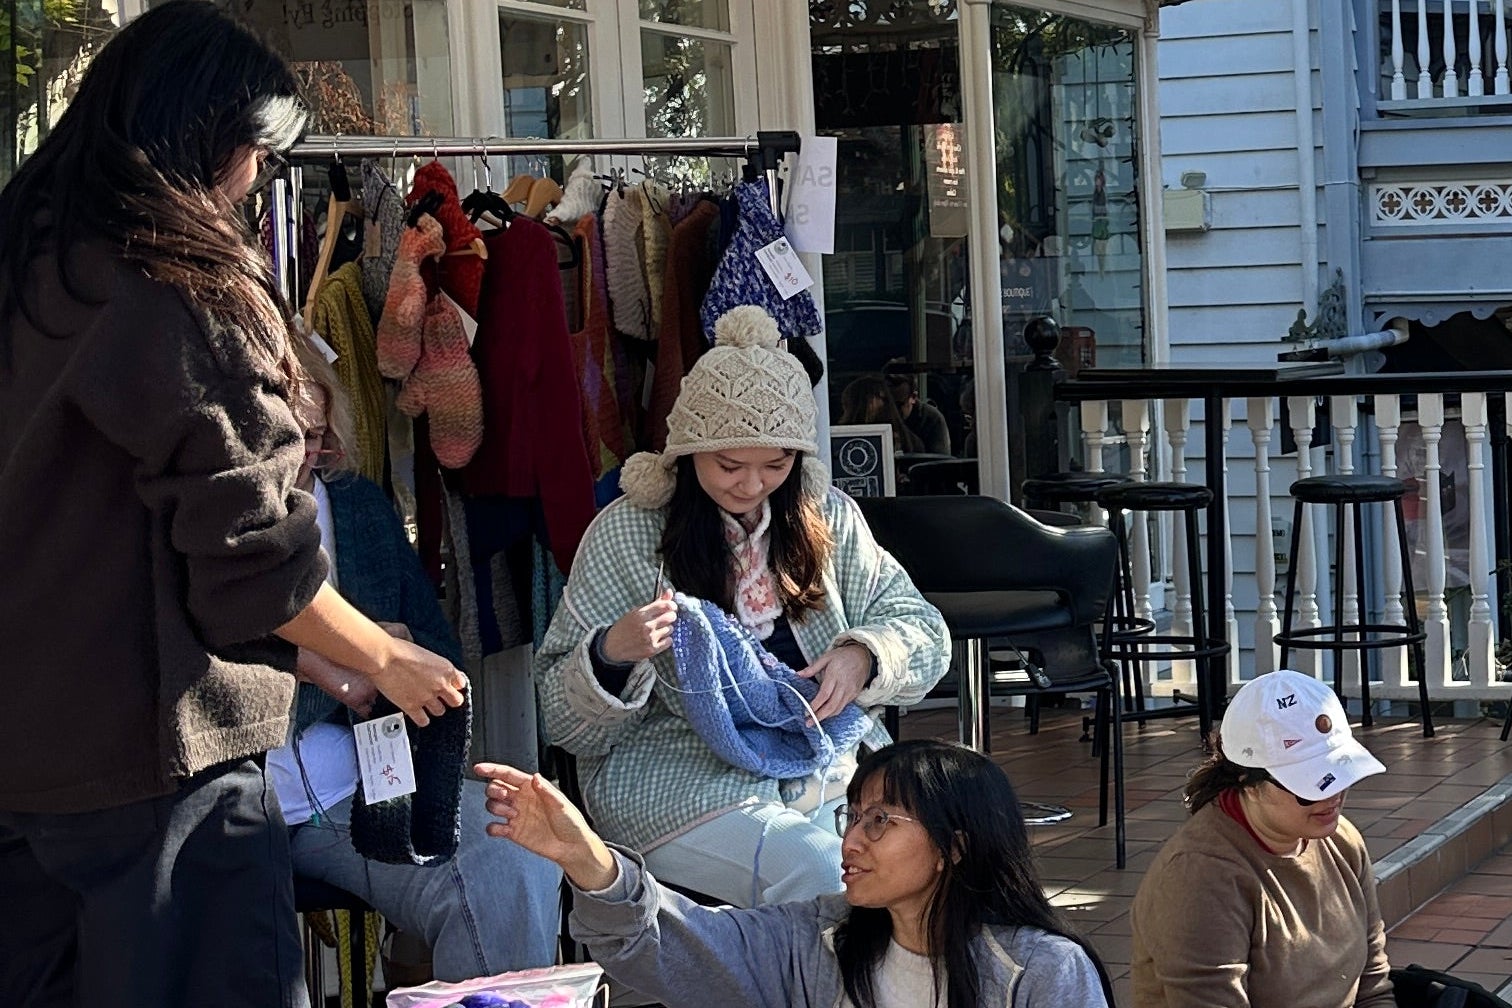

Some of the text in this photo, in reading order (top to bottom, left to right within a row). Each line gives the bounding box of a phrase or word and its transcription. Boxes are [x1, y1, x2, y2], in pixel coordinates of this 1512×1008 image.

[784, 272, 799, 286] $10
[1276, 693, 1297, 709] NZ
[380, 763, 401, 786] $15
